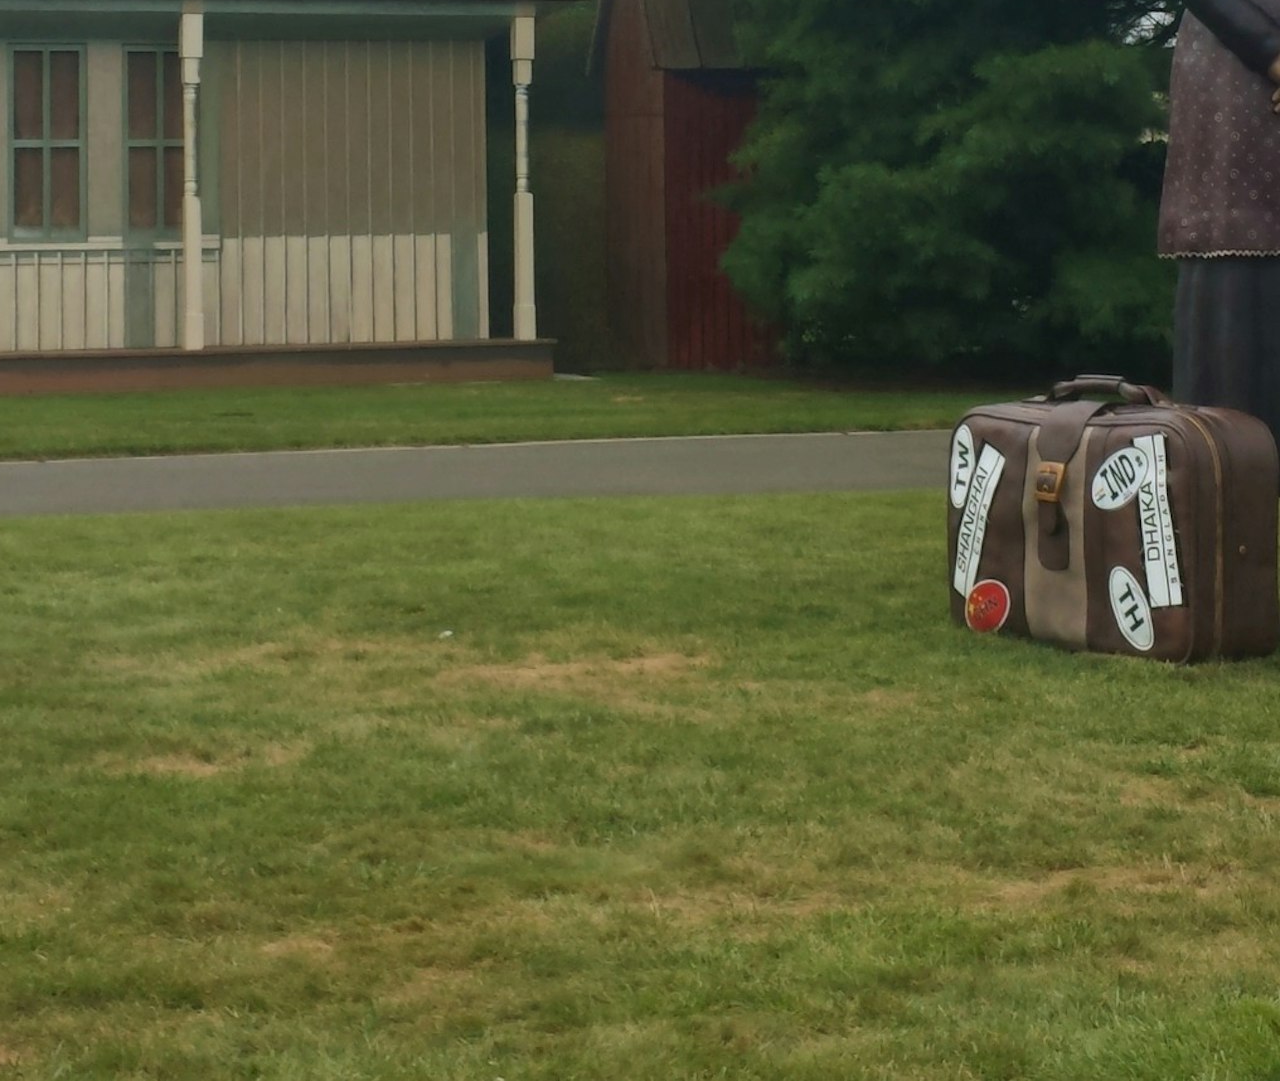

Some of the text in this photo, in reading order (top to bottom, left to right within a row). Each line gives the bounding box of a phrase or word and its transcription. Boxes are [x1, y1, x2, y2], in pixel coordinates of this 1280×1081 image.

[954, 440, 970, 491] TW
[1100, 455, 1135, 501] IND
[958, 467, 989, 573] SHANGHAI
[974, 503, 988, 556] CHINA
[1141, 481, 1160, 561] DHAKA
[1158, 454, 1178, 583] BANGLADESH
[1119, 582, 1144, 632] TH
